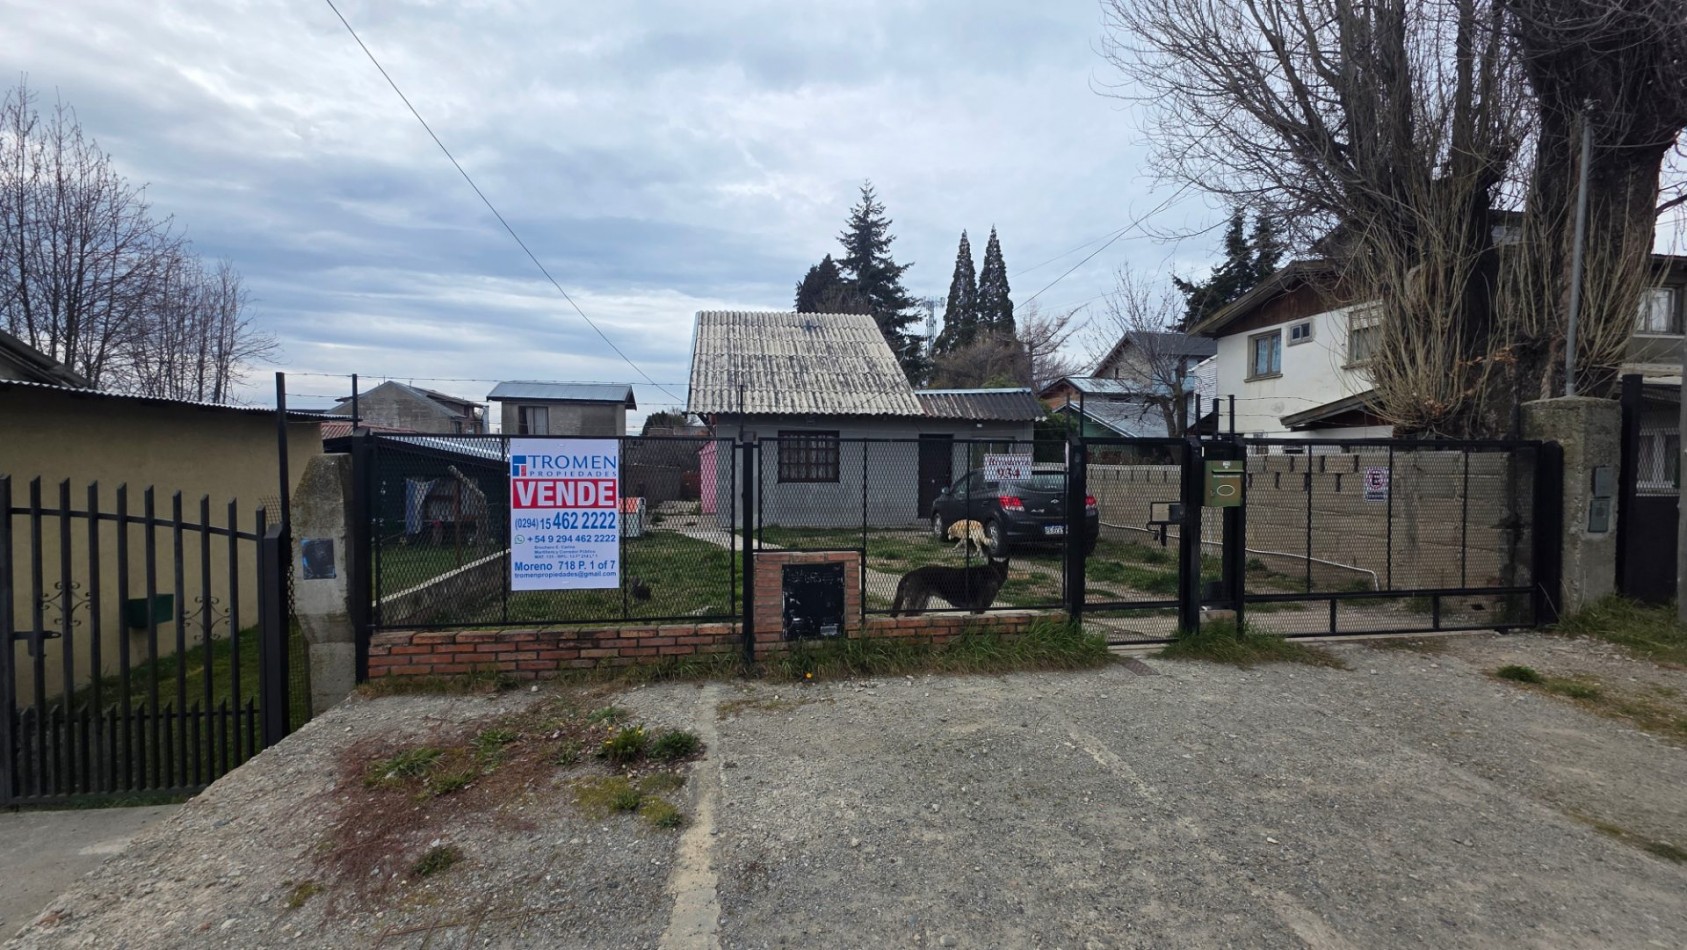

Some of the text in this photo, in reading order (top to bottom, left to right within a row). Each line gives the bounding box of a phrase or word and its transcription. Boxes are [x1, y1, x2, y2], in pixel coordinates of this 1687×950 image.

[528, 455, 616, 469] TROMEN
[516, 481, 614, 506] VENDE
[514, 511, 616, 530] (0294) 15 462 2222
[547, 535, 554, 543] 9
[556, 534, 573, 543] 294
[575, 534, 592, 543] 462
[594, 534, 616, 543] 2222
[514, 562, 553, 571] Moreno
[558, 561, 576, 570] 718
[578, 561, 586, 570] P.
[598, 560, 607, 569] of
[610, 560, 616, 569] 7
